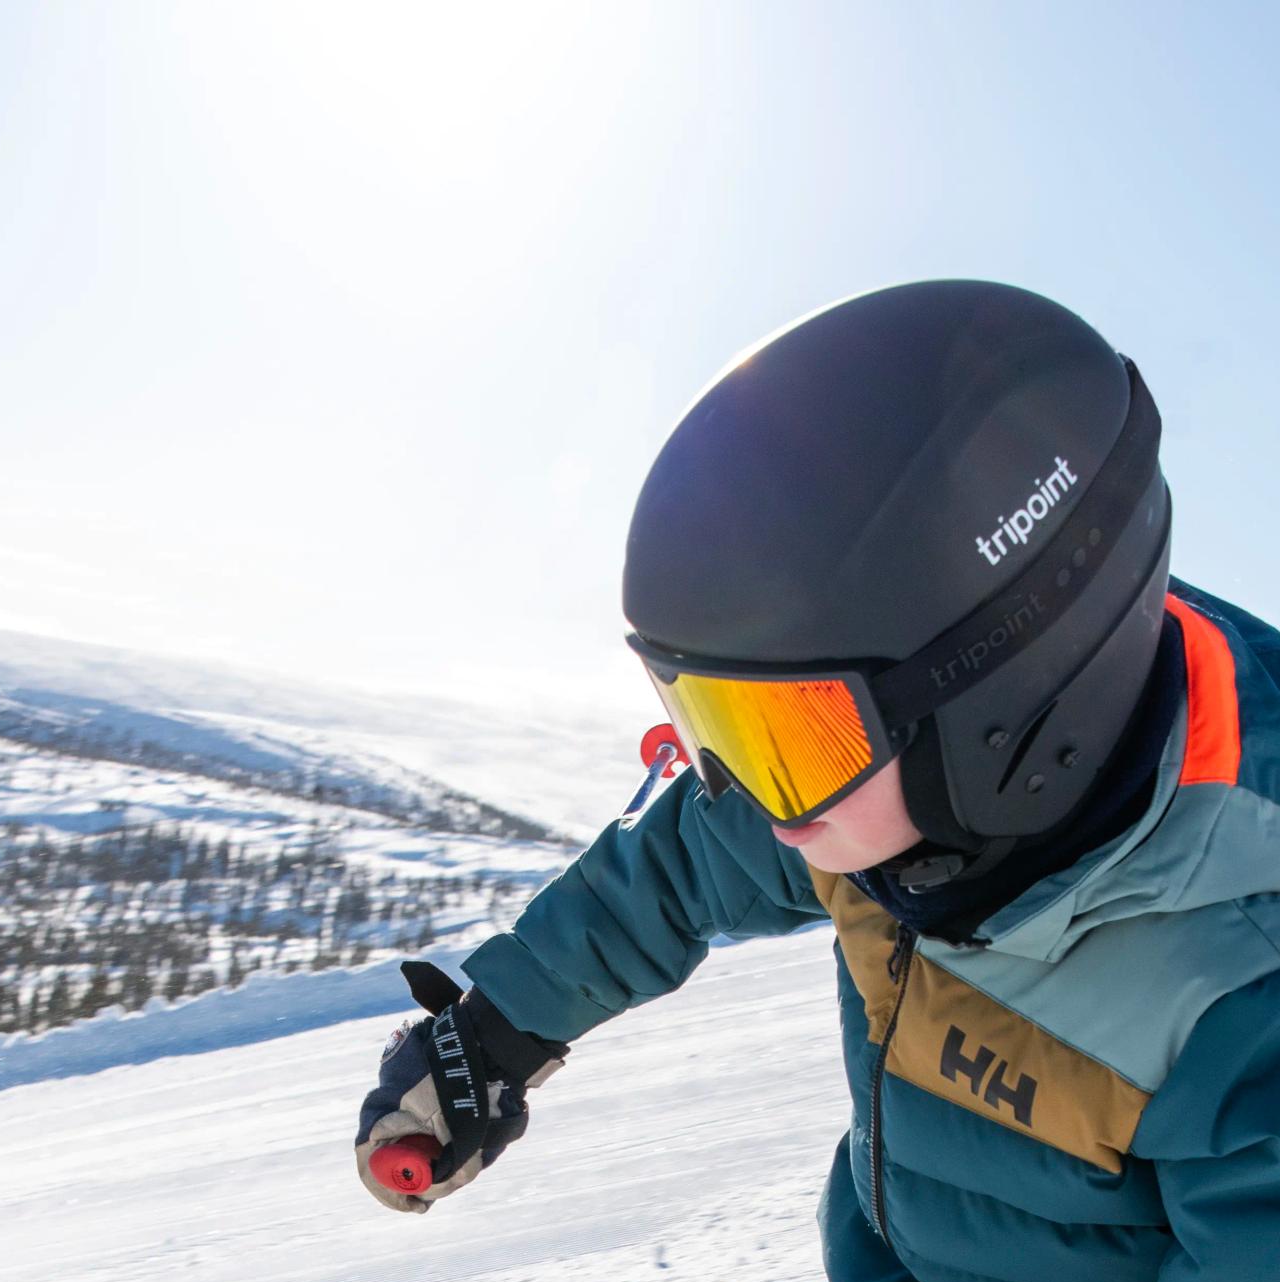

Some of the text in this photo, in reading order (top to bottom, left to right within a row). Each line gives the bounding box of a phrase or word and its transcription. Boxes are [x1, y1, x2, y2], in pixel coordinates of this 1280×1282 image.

[976, 456, 1078, 566] tripoint
[930, 592, 1046, 689] tripoint
[940, 1024, 1038, 1129] HH
